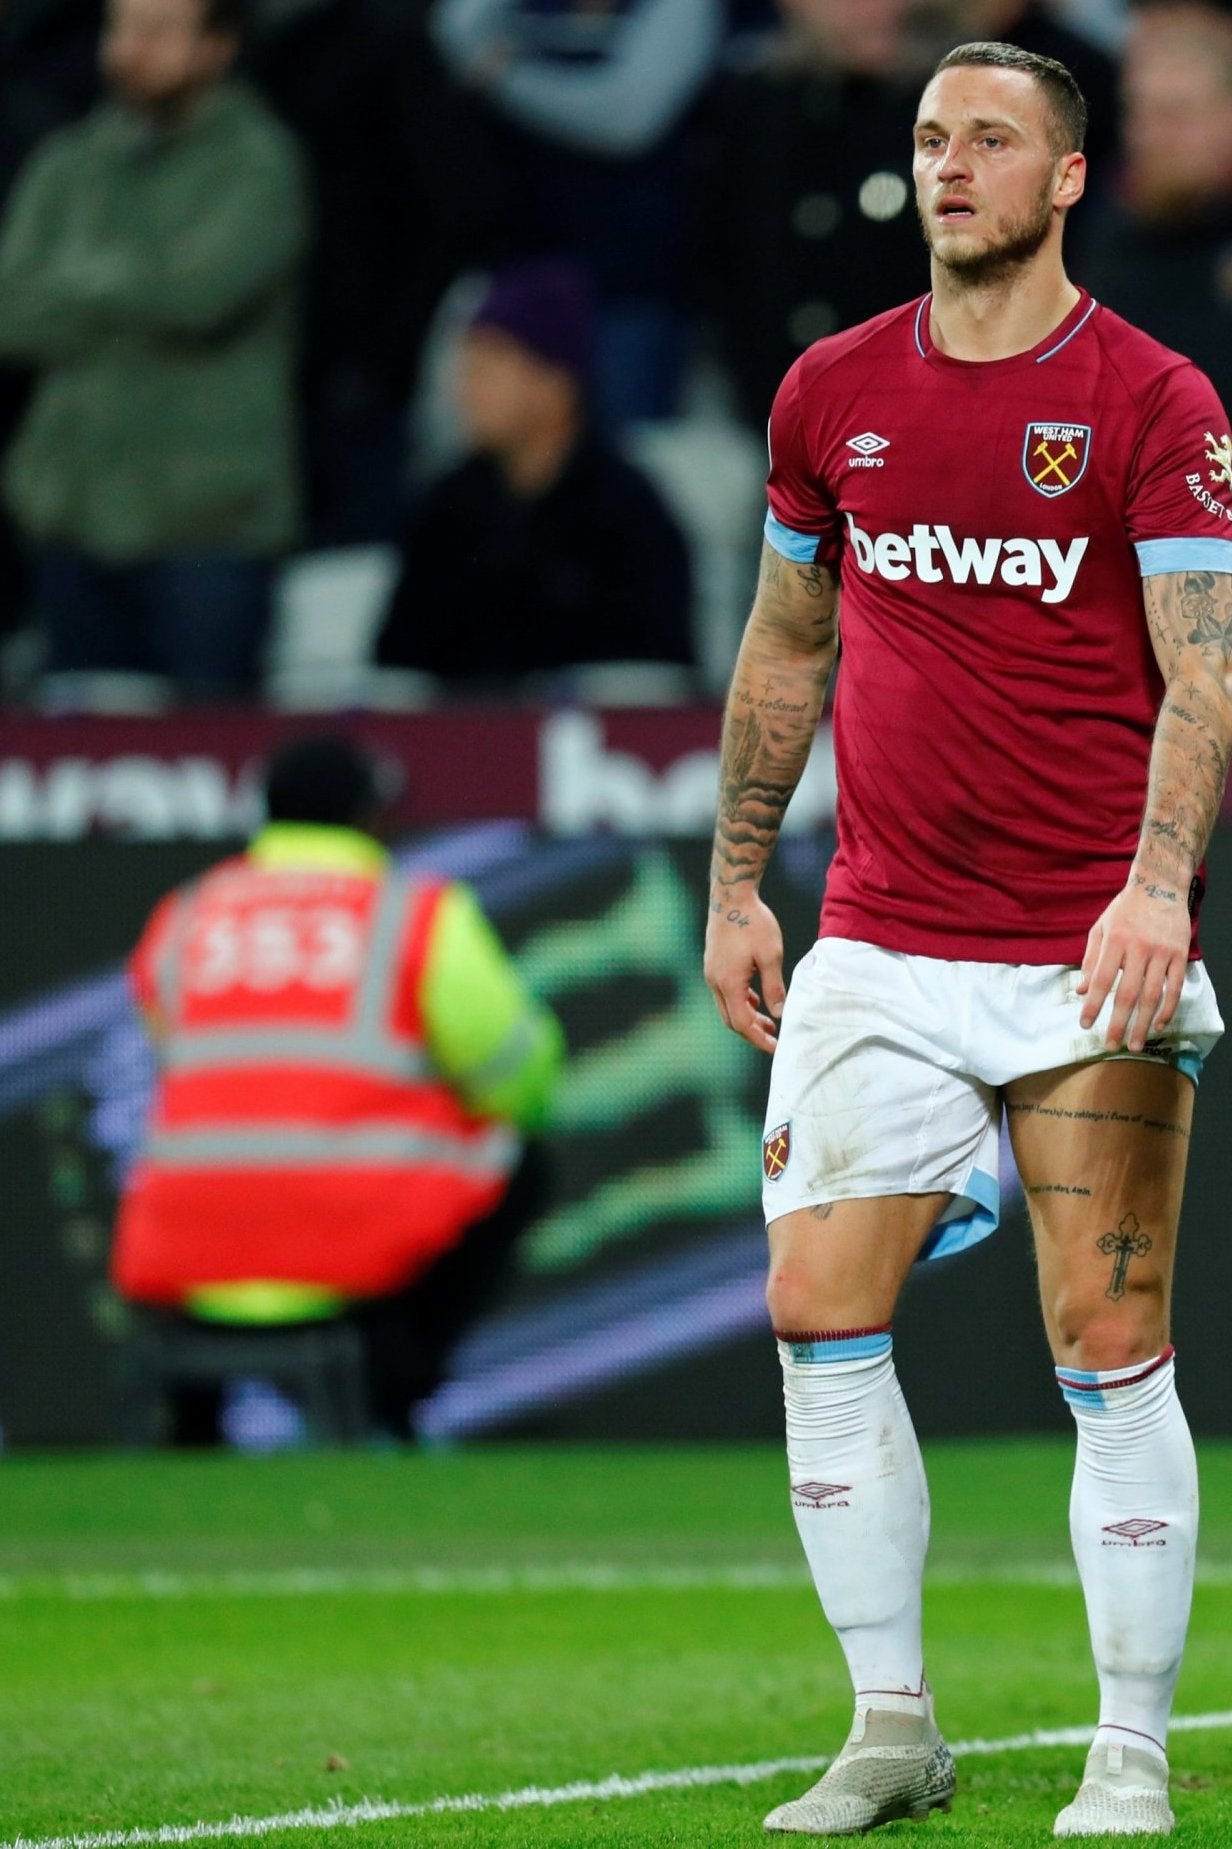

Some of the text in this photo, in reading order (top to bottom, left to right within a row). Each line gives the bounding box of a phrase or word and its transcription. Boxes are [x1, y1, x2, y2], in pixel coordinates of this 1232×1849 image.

[1034, 426, 1084, 438] WEST HAM
[1043, 433, 1073, 442] UNITED
[848, 454, 885, 468] umbro
[1185, 472, 1225, 519] BASSET
[844, 511, 1090, 604] betway
